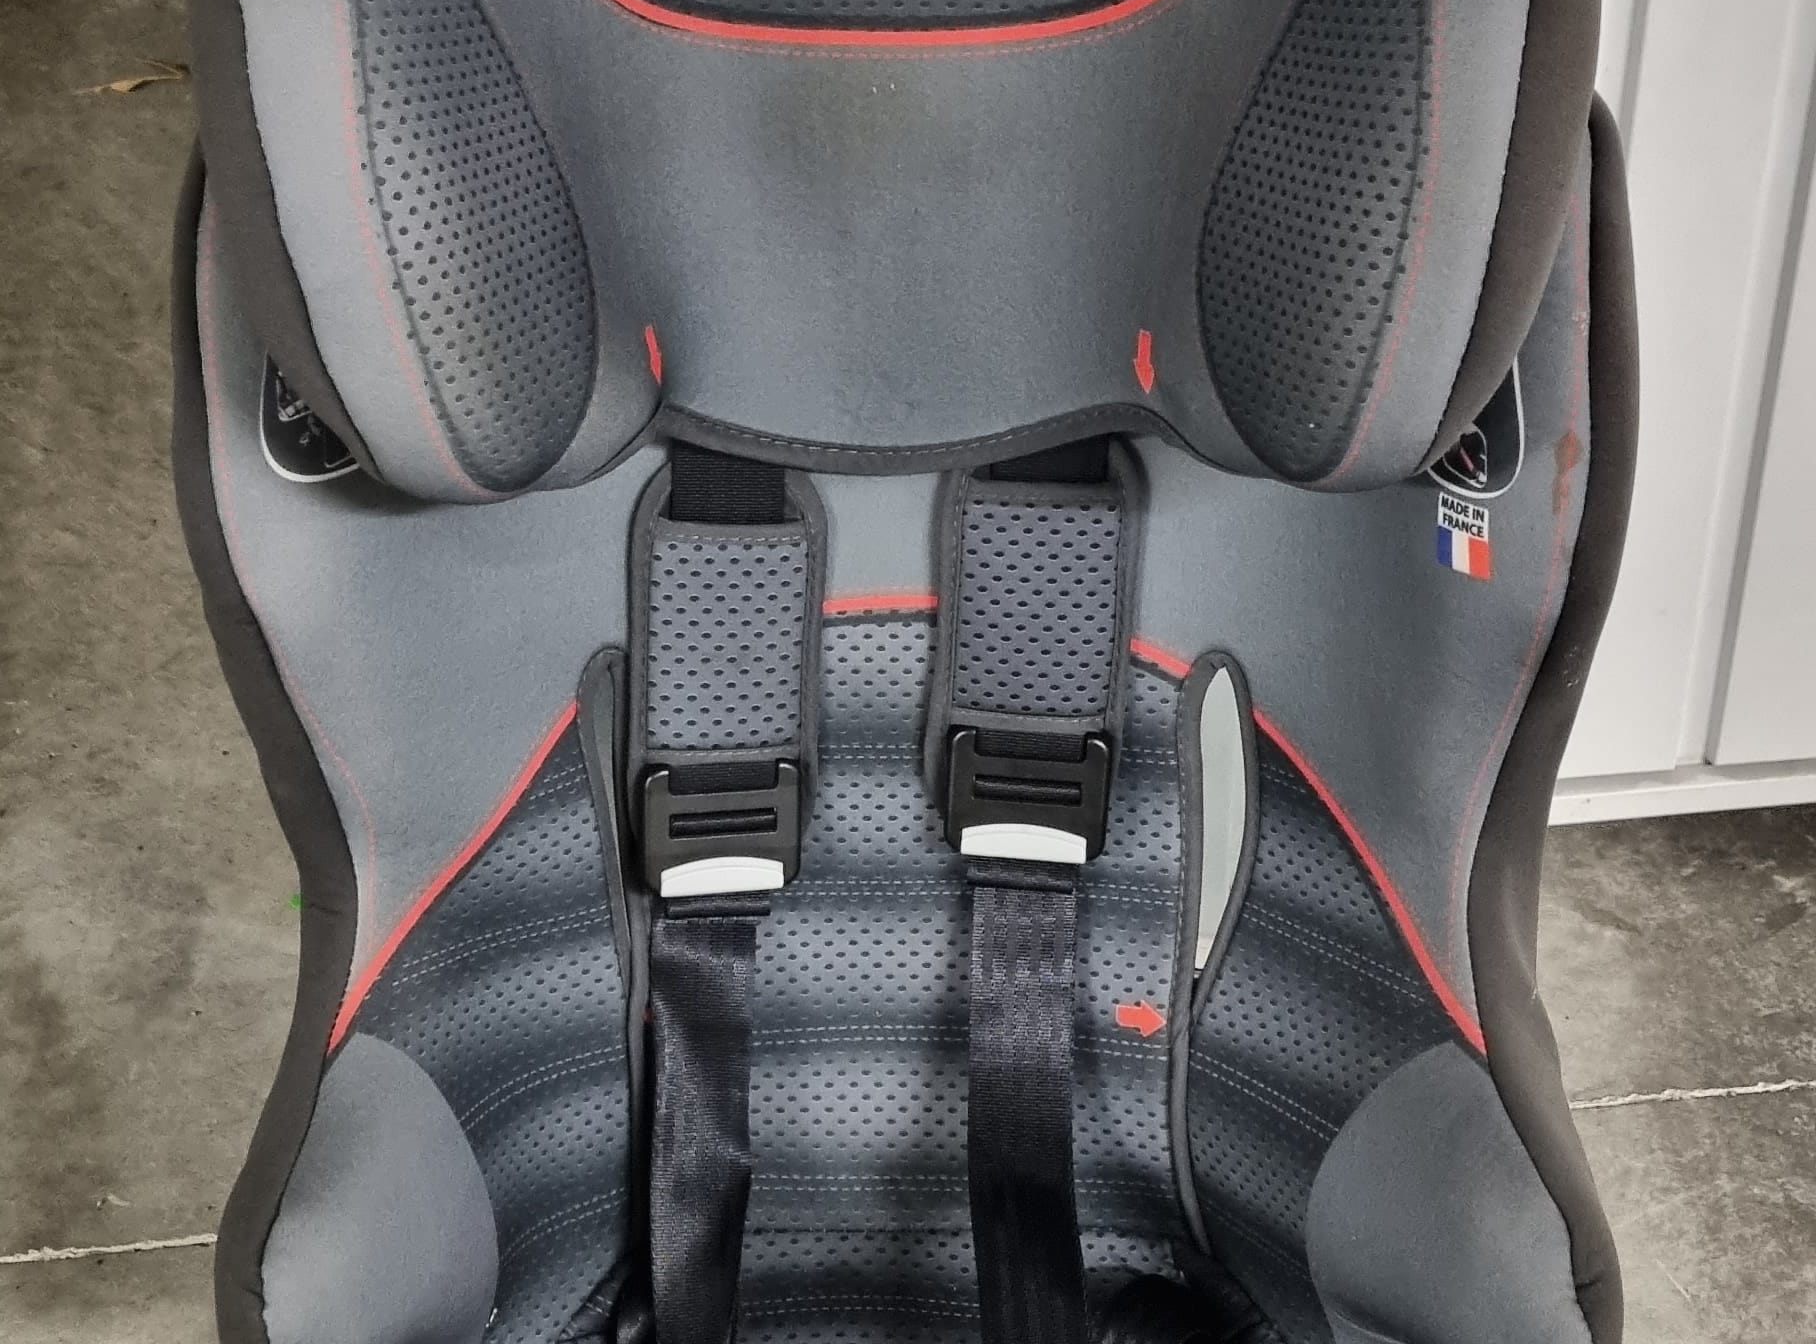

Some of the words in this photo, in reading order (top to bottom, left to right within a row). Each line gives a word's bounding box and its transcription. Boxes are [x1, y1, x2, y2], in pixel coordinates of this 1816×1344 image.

[1441, 496, 1470, 518] MADE
[1472, 508, 1484, 522] IN
[1442, 513, 1484, 538] FRANCE
